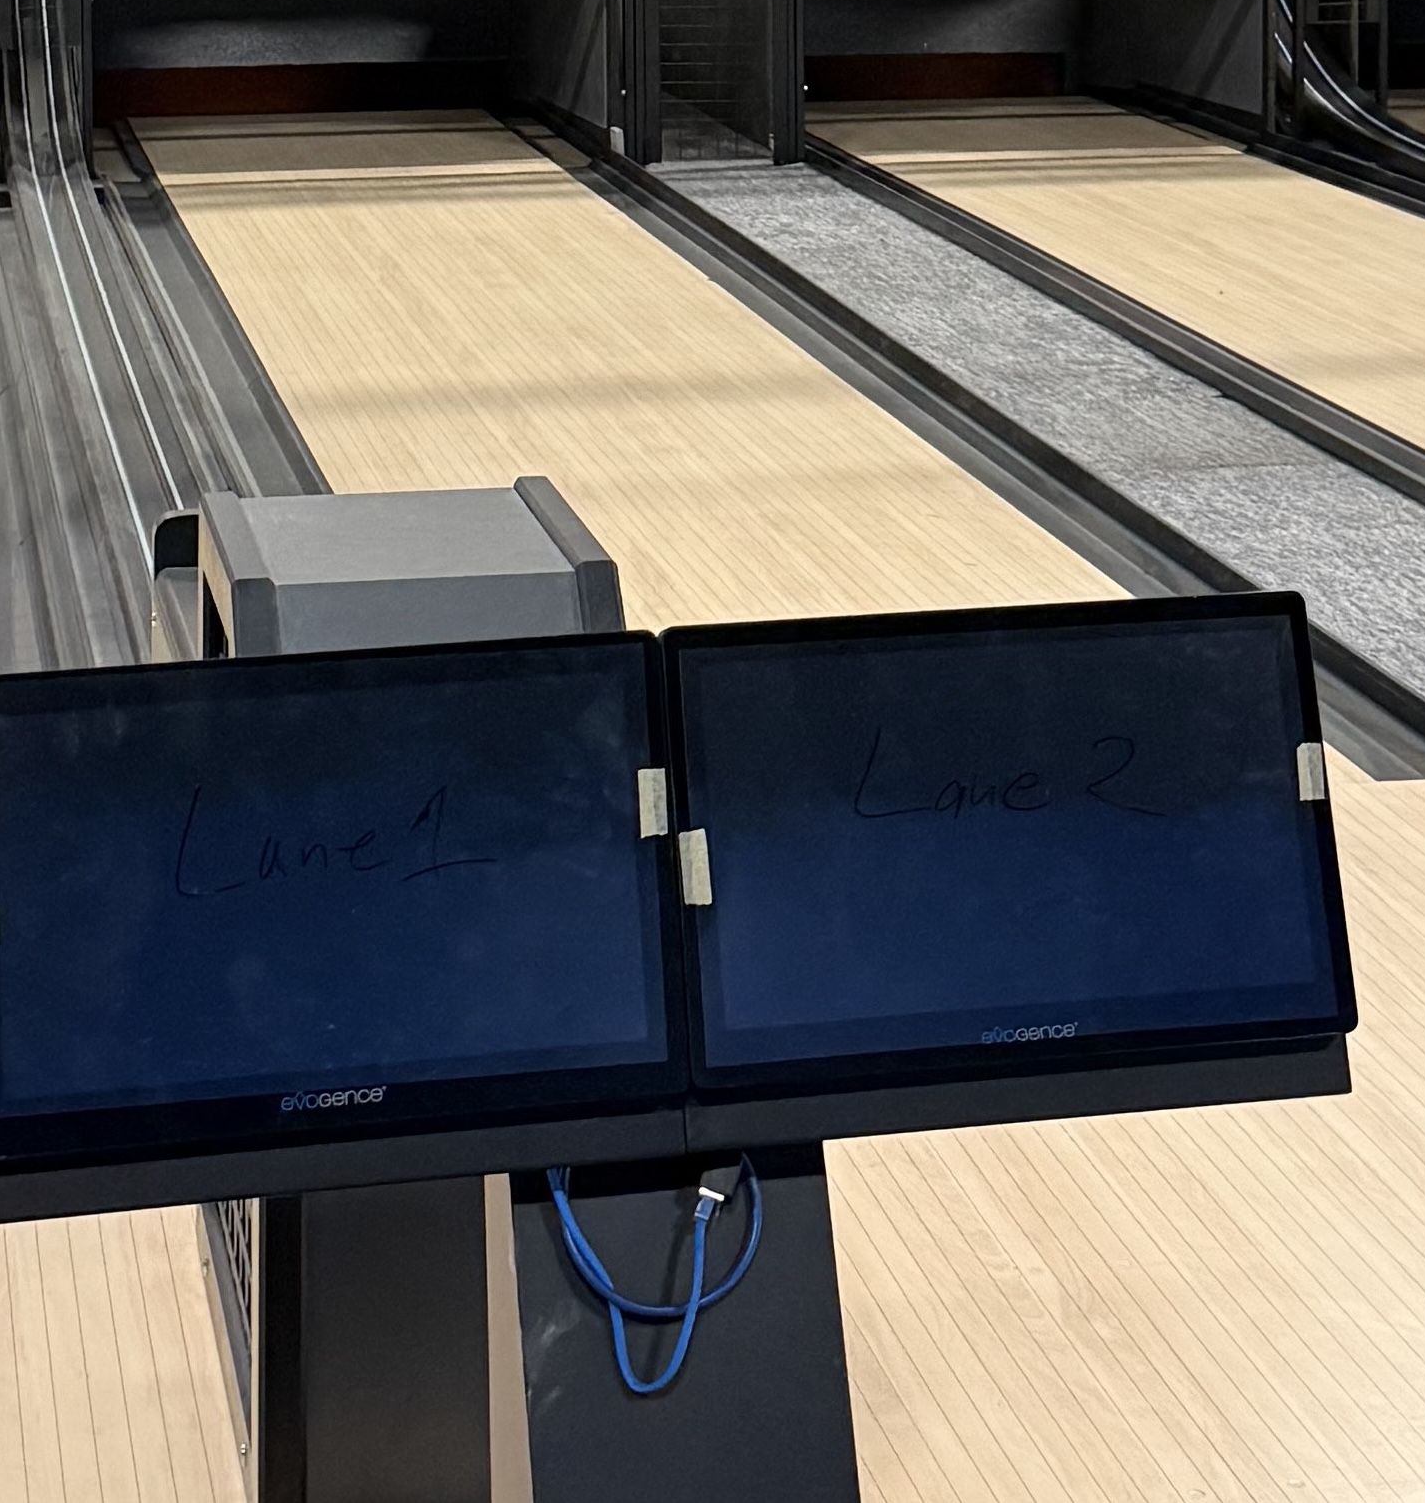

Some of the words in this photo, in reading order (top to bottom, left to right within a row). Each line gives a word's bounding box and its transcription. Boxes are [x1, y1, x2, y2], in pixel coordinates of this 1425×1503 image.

[853, 726, 1052, 819] Lane
[1086, 736, 1169, 817] 2
[176, 783, 393, 896] Lane
[398, 784, 499, 882] 1
